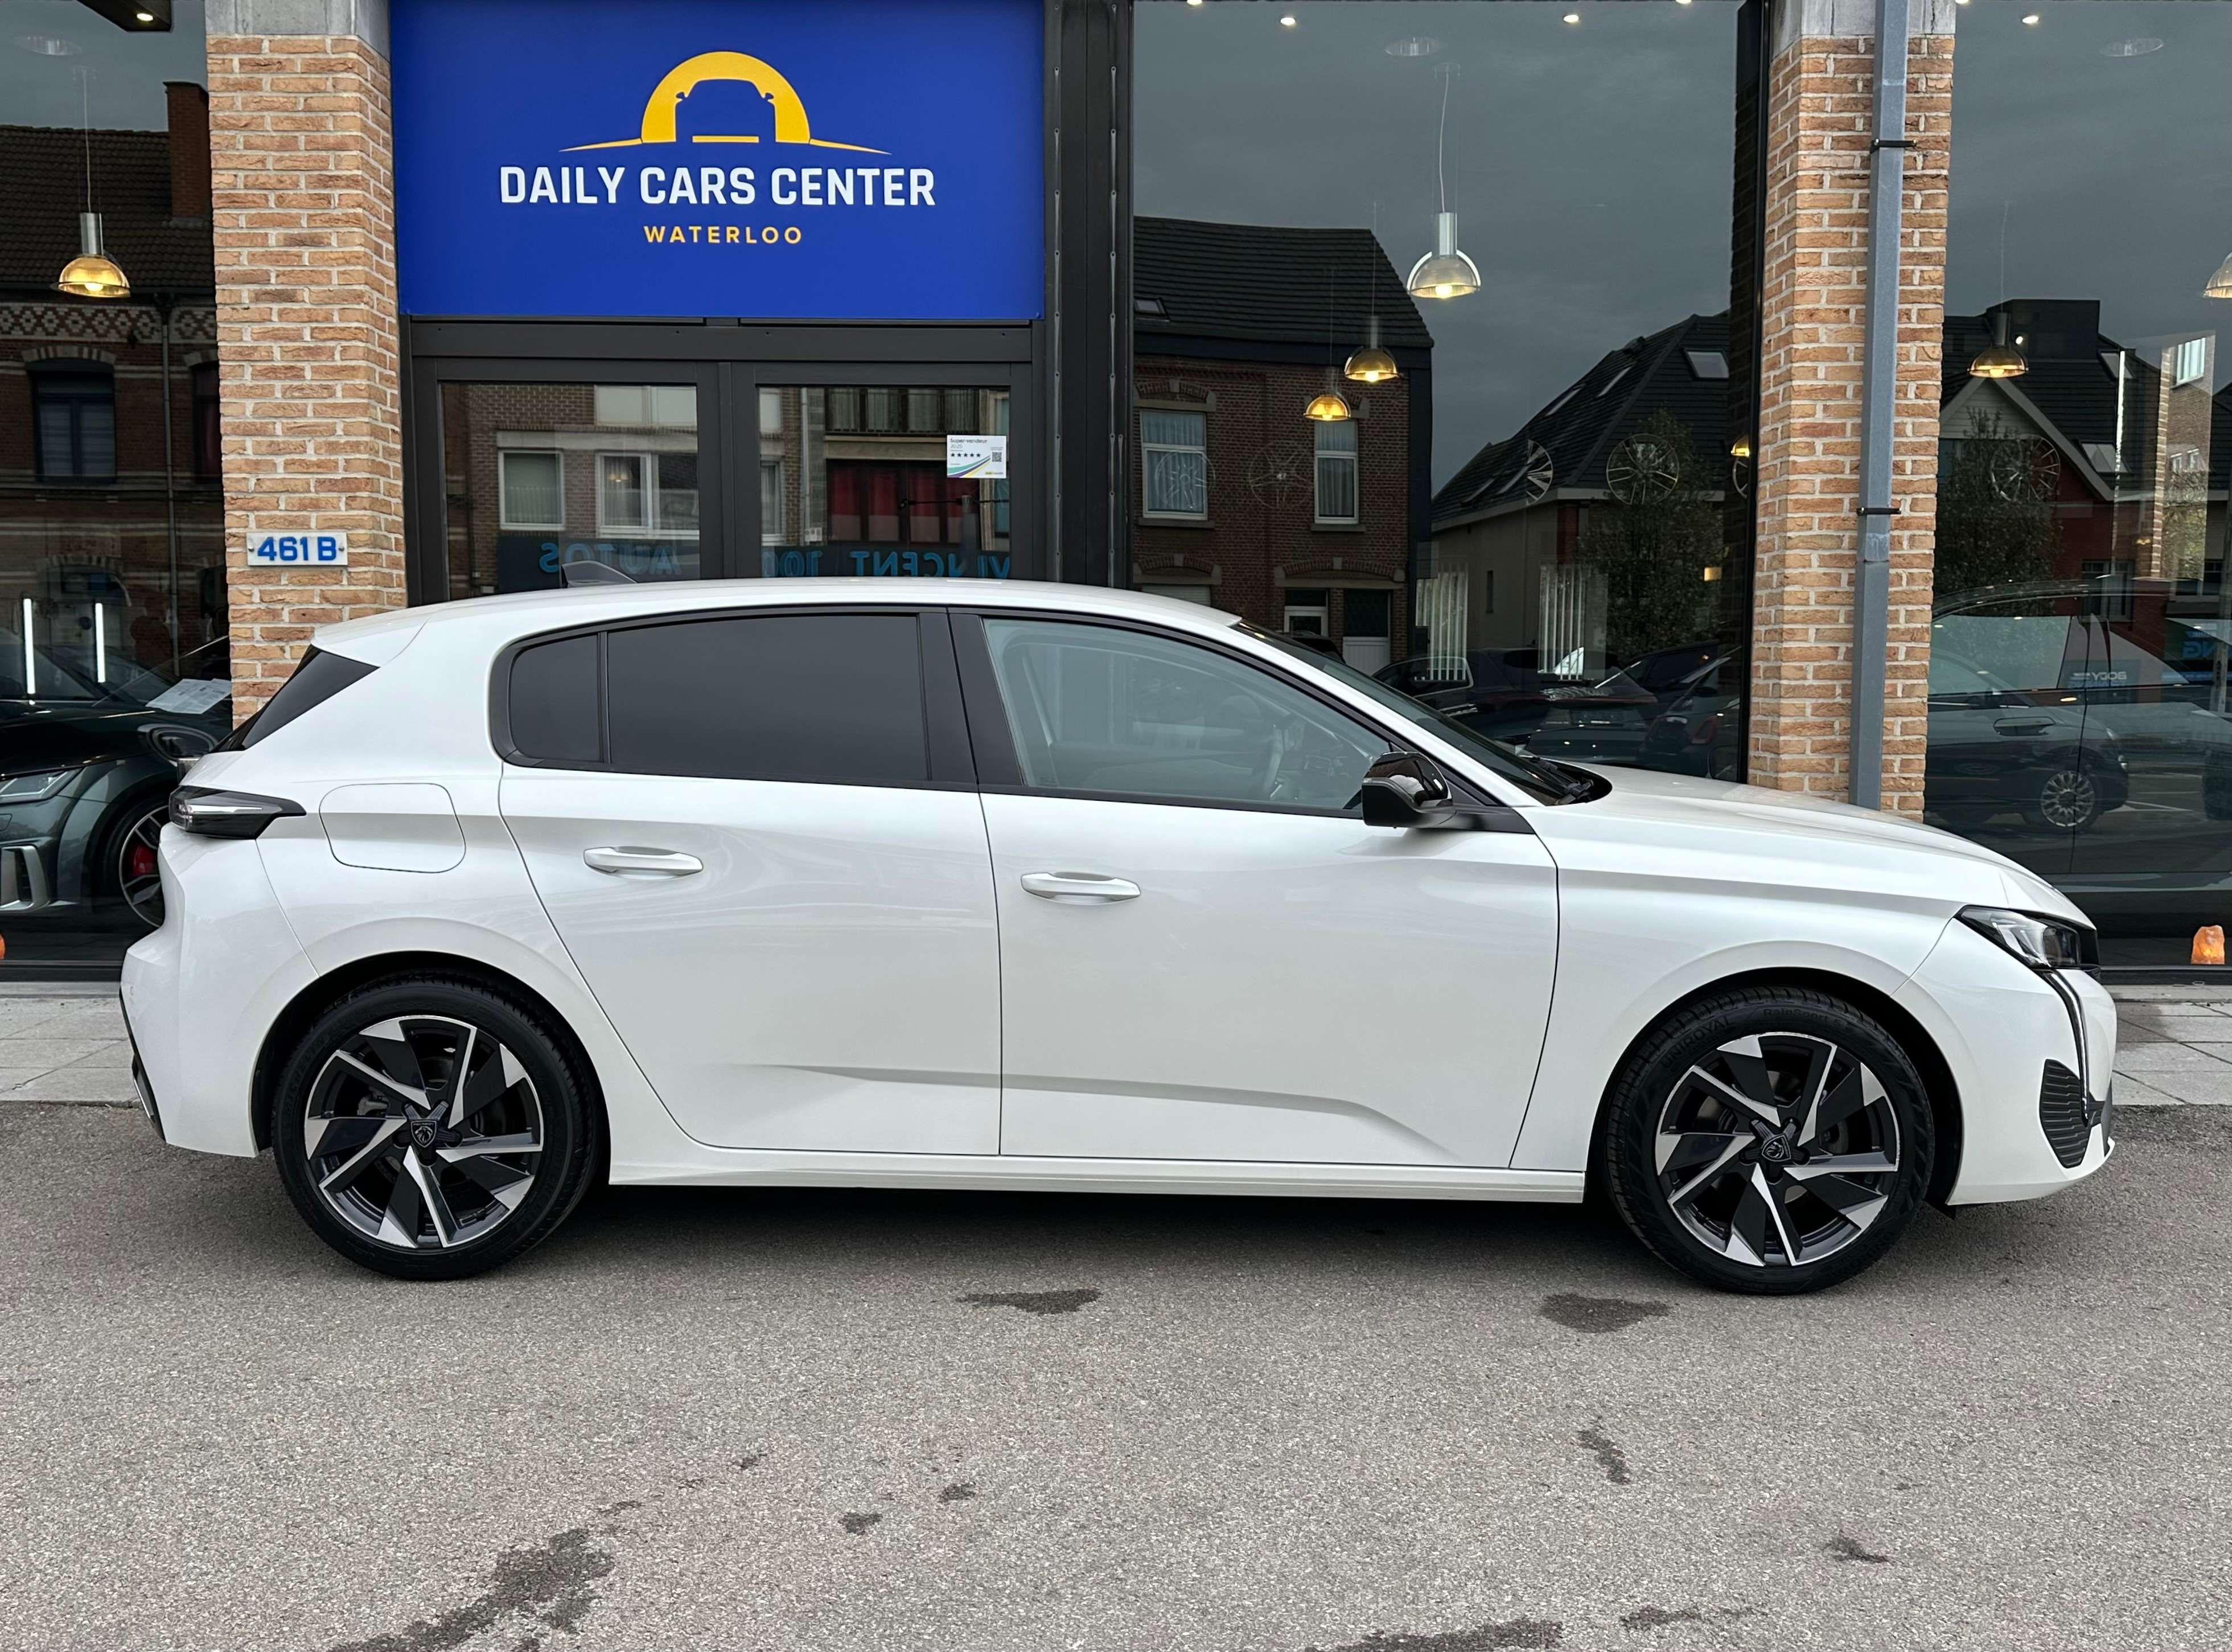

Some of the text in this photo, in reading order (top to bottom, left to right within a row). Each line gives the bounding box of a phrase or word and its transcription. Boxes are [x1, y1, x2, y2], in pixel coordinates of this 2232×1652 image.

[500, 166, 935, 206] DAILY CARS CENTER
[643, 226, 801, 244] WATERLOO
[257, 536, 336, 561] 461 B
